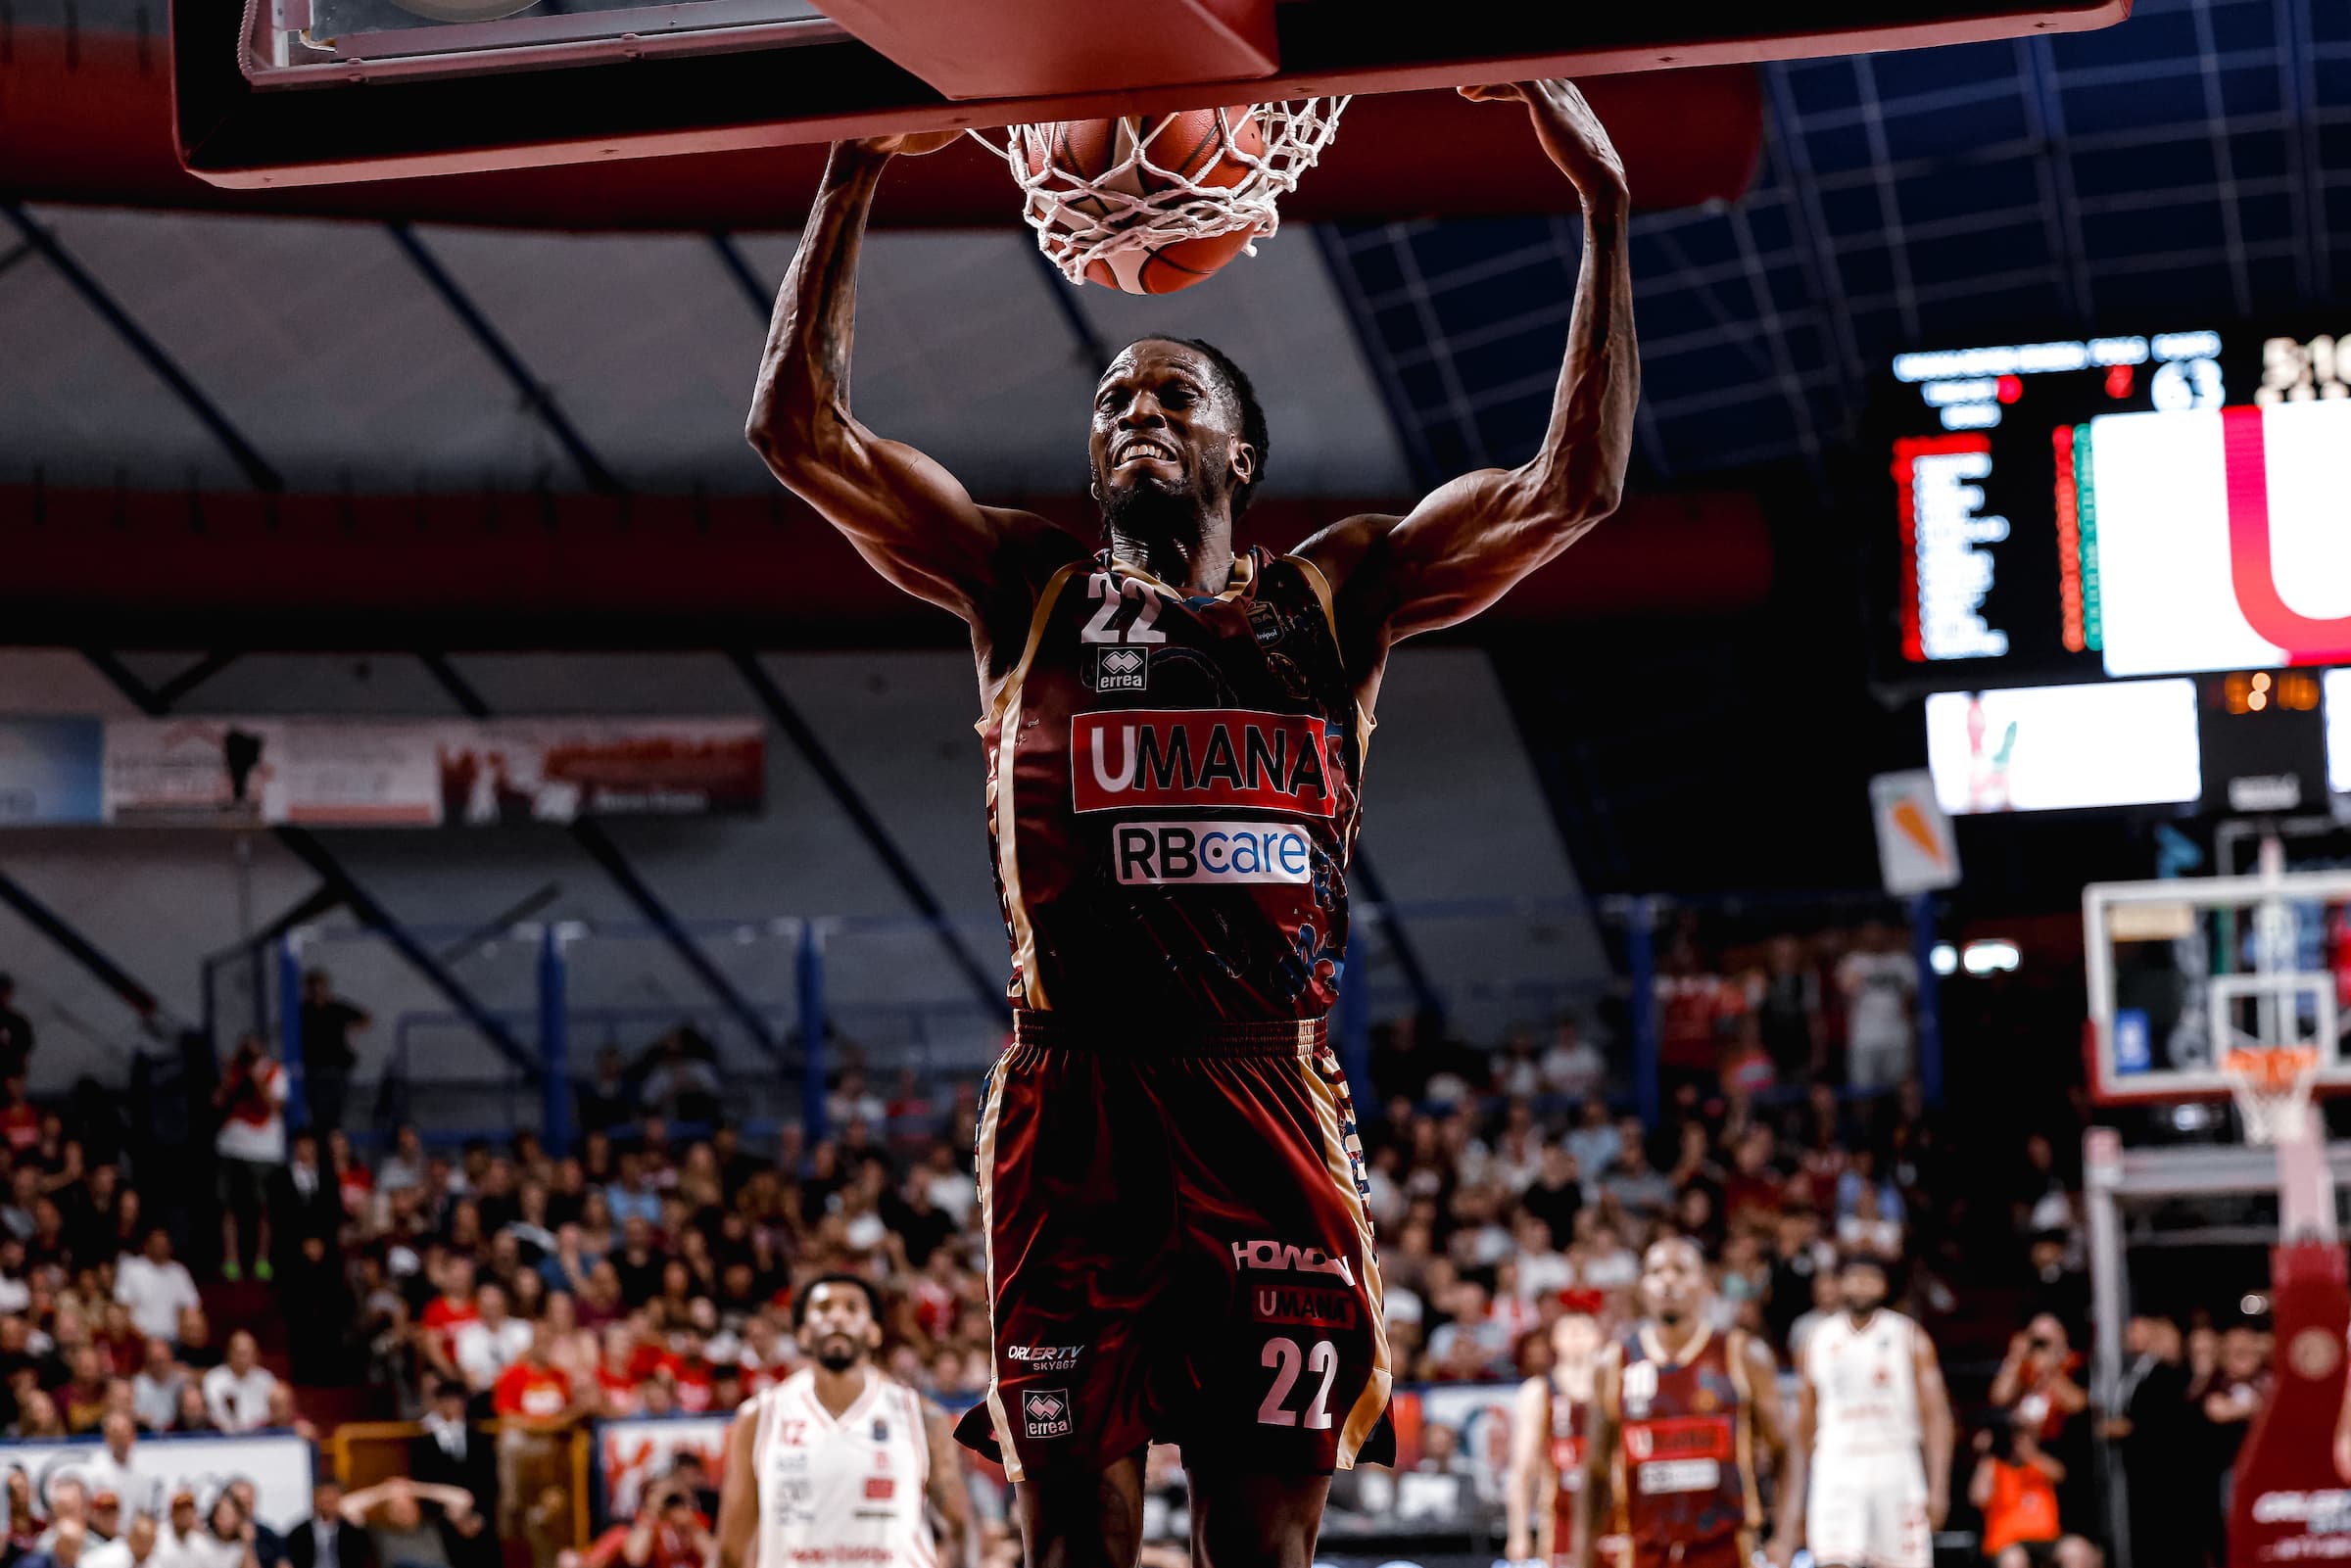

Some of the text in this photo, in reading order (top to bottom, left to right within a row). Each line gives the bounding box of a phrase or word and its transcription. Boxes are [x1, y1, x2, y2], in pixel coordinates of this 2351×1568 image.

[1081, 571, 1166, 643] 22
[1091, 724, 1327, 800] UMANA
[1119, 828, 1306, 879] RBcare
[1259, 1290, 1348, 1322] UMANA
[1032, 1359, 1077, 1371] SKY867
[1257, 1337, 1338, 1430] 22
